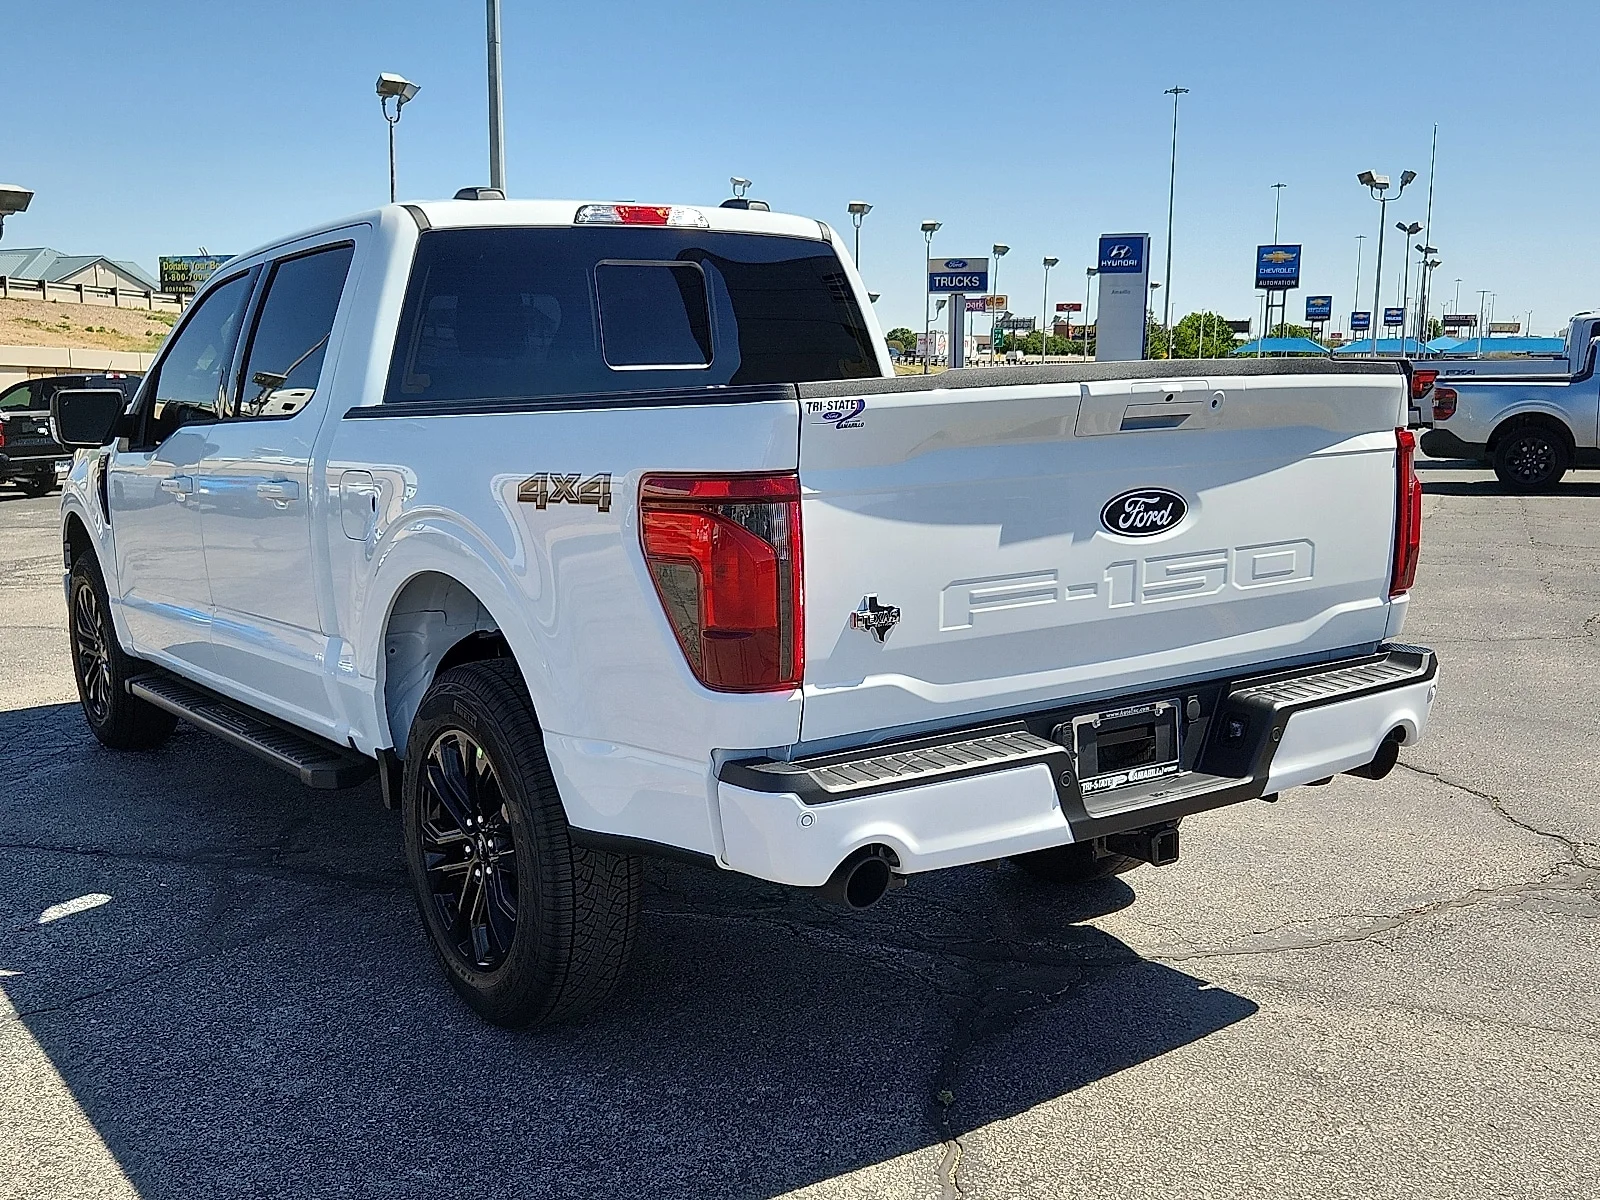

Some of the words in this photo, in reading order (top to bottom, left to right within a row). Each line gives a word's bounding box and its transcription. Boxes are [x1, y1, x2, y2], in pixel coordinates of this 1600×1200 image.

[163, 262, 189, 271] Donate
[191, 262, 208, 271] Your
[1101, 259, 1138, 268] HYUNDAI
[933, 276, 980, 288] TRUCKS
[1258, 279, 1296, 287] AUTONATION
[805, 399, 857, 414] TRI-STATE
[1118, 496, 1174, 529] Ford
[939, 537, 1315, 632] F-150
